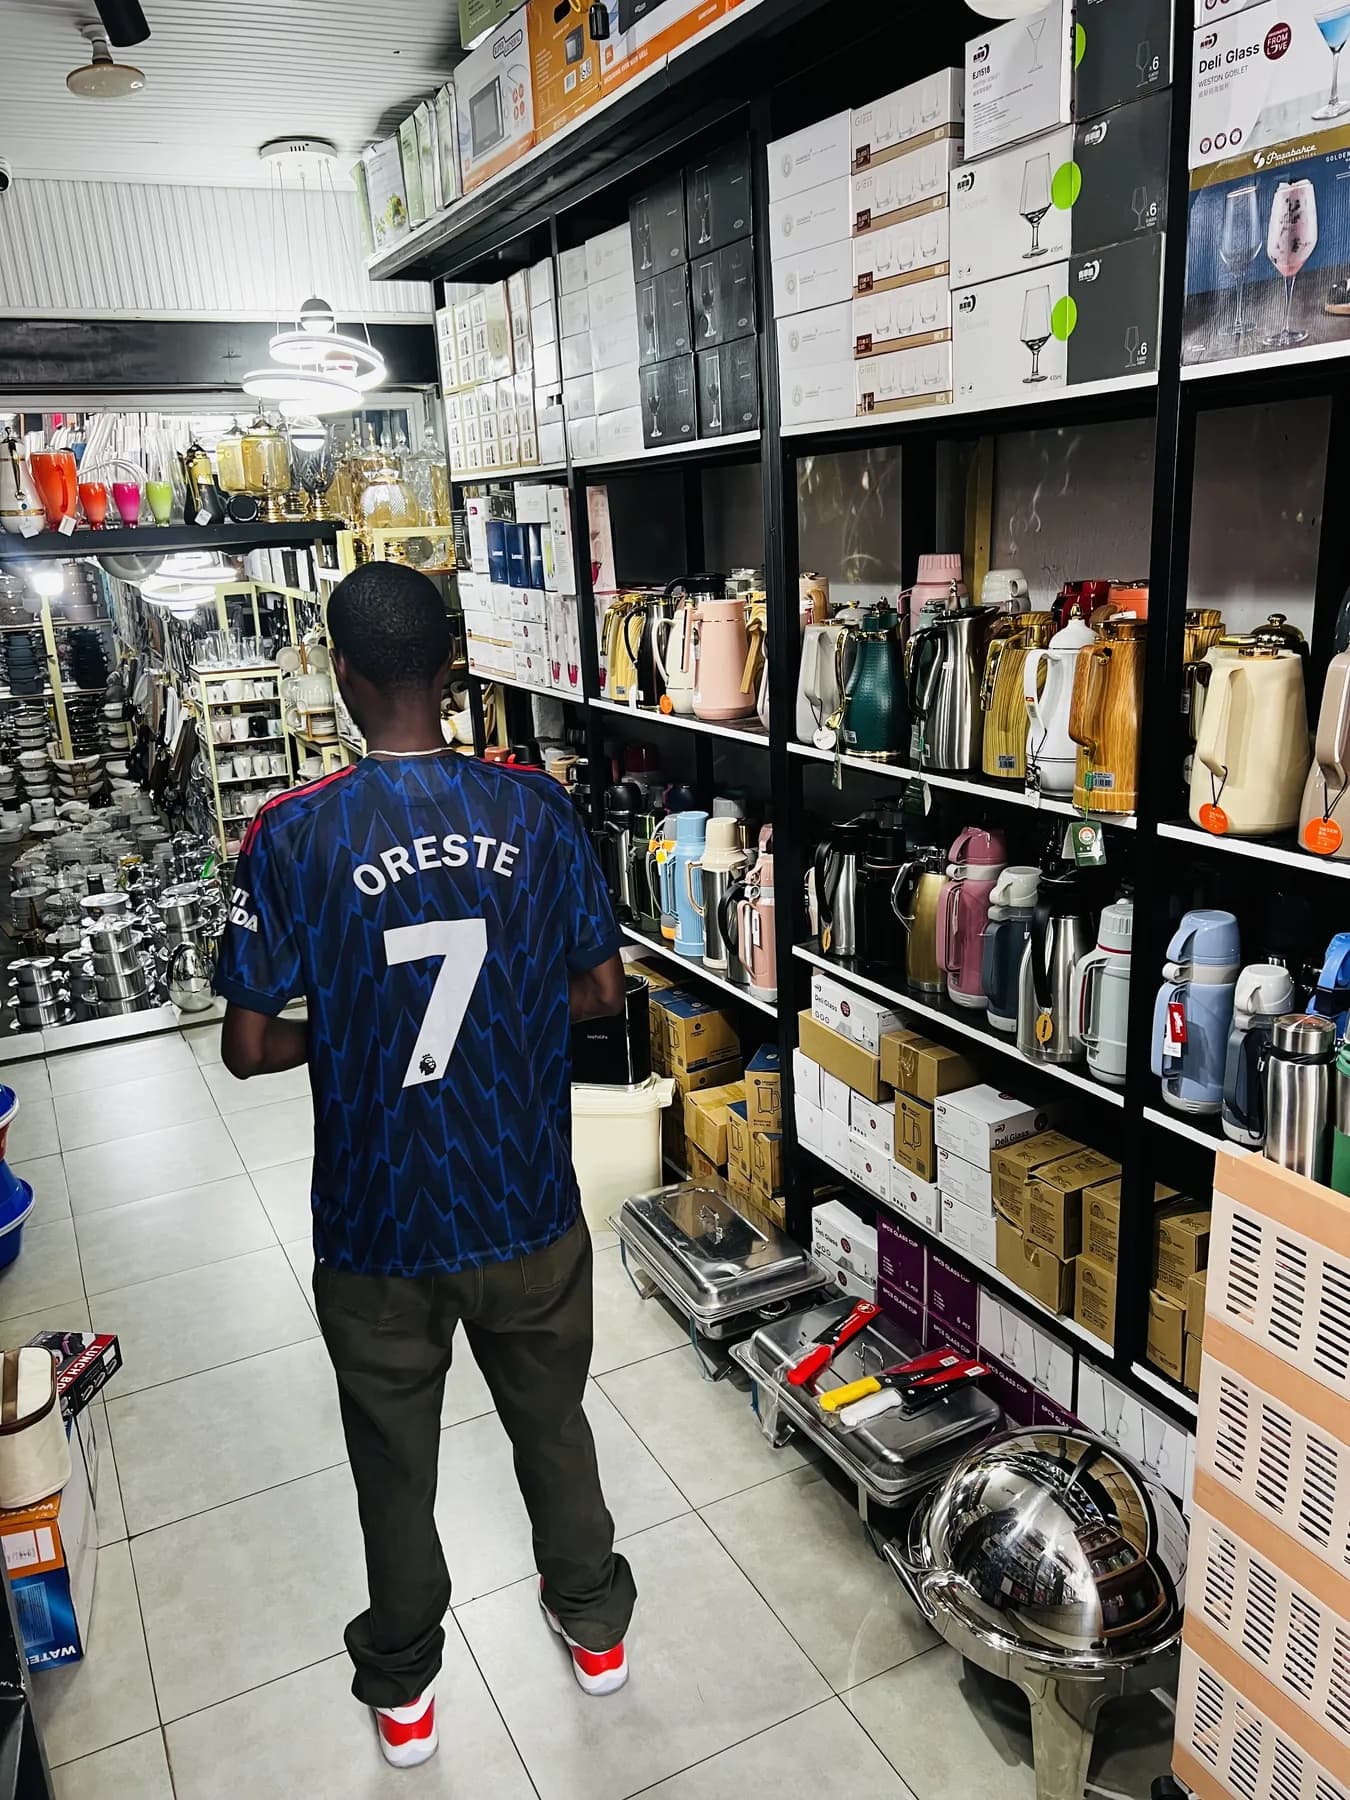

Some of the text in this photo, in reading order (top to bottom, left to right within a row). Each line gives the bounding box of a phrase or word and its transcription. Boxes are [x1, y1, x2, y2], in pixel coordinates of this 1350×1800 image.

[1267, 33, 1288, 47] FROM
[1199, 43, 1260, 74] Deli Glass
[1198, 74, 1224, 88] WESTON
[352, 834, 520, 896] ORESTE
[231, 885, 250, 907] IT
[383, 918, 488, 1089] 7
[67, 1345, 102, 1375] LUNCH
